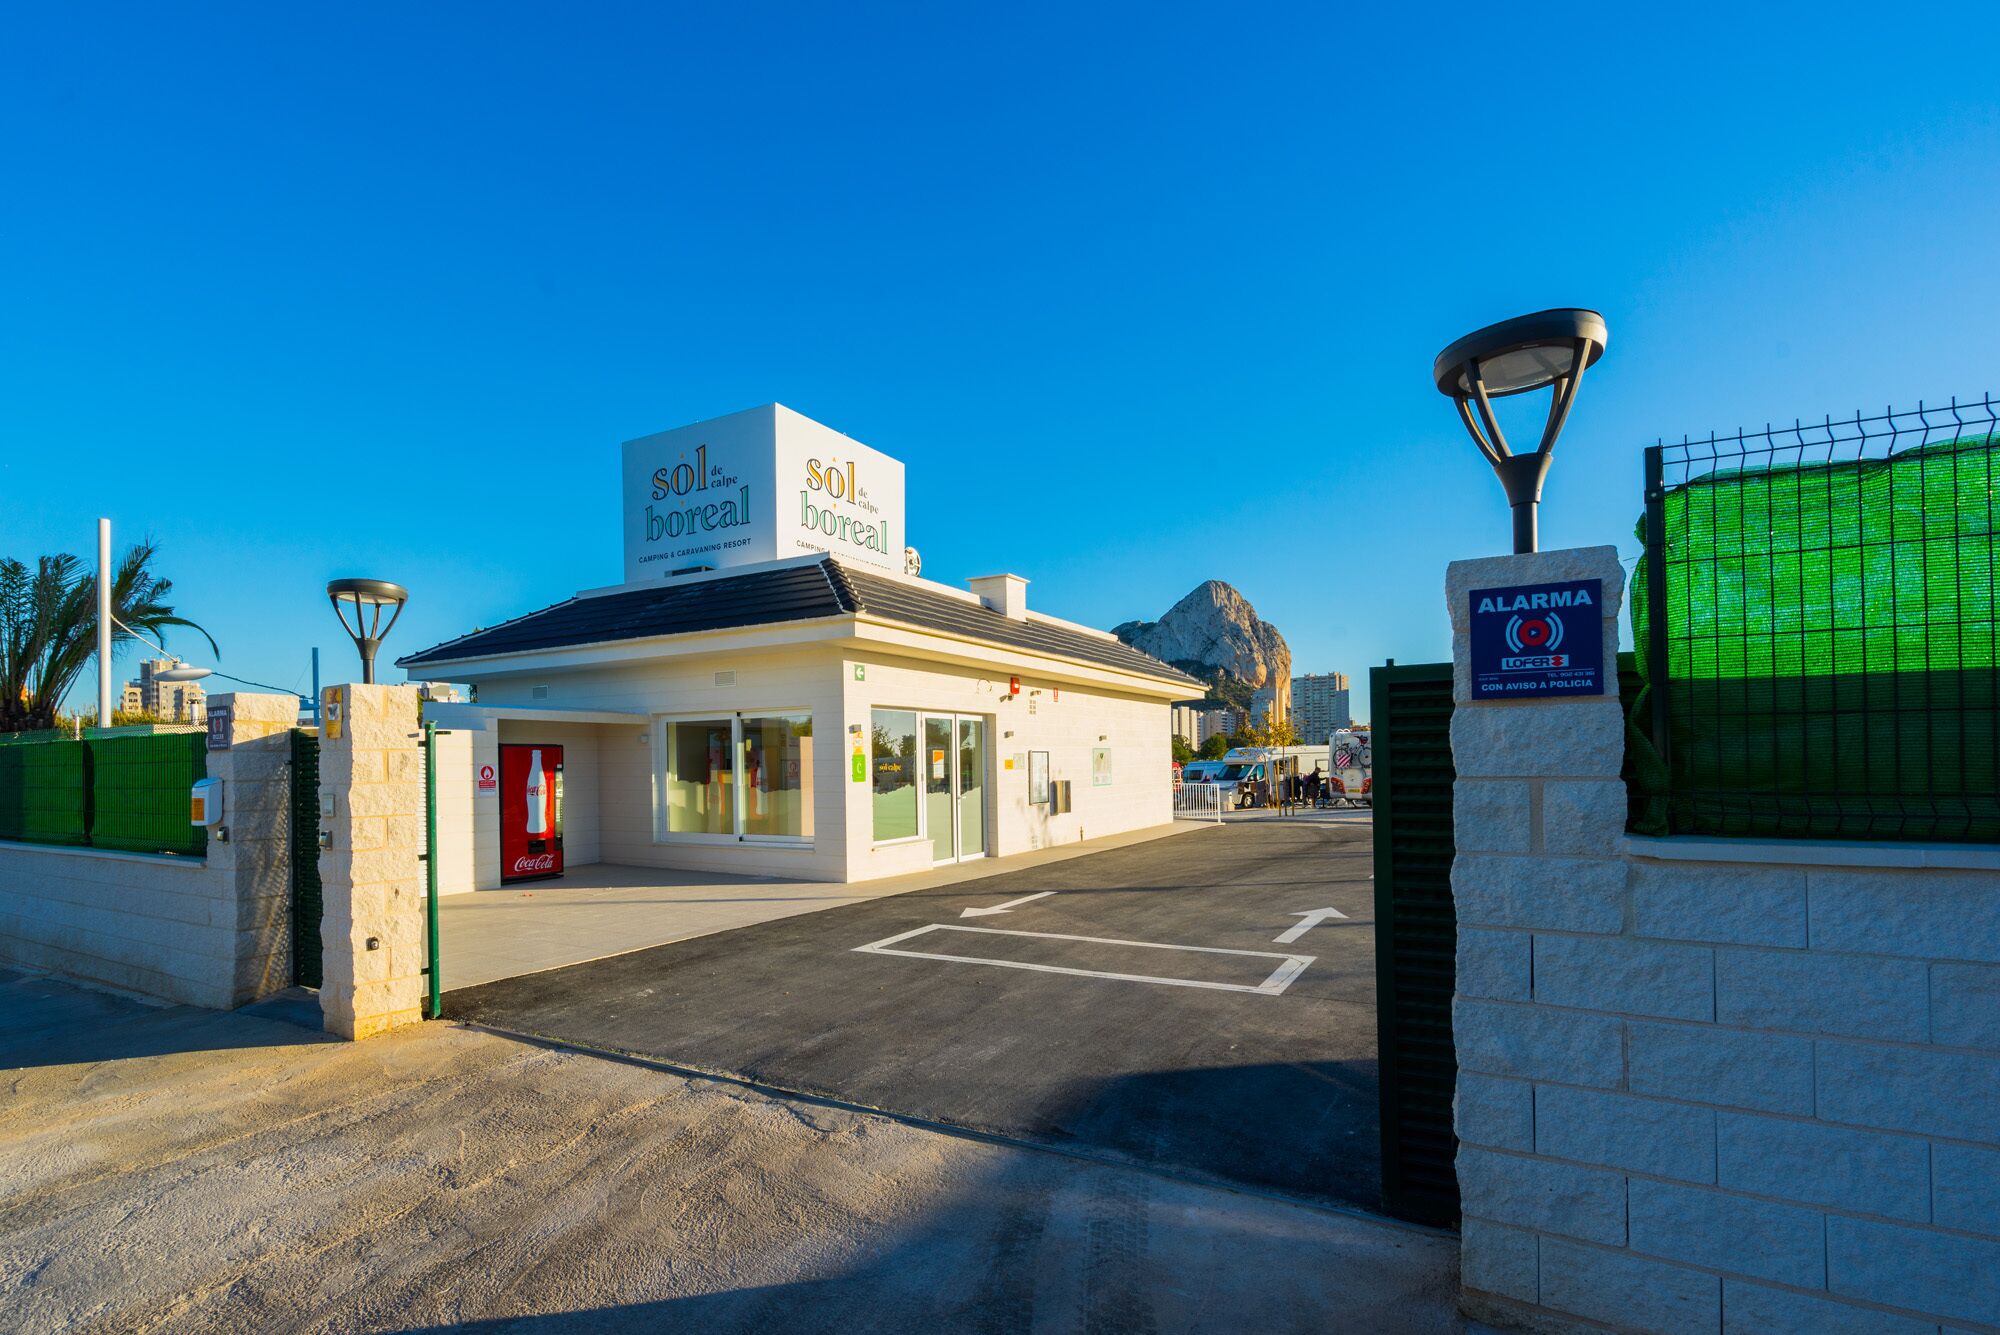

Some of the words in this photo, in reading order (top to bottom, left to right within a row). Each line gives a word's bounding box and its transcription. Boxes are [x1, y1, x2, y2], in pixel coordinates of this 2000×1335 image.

[651, 444, 707, 501] sol
[711, 465, 723, 476] de
[710, 474, 738, 489] calpe
[806, 458, 857, 506] sol
[858, 487, 868, 499] de
[645, 484, 751, 542] boreal
[858, 499, 879, 515] calpe
[800, 490, 889, 556] boreal
[638, 551, 669, 564] CAMPING
[677, 543, 721, 558] CARAVANING
[723, 537, 752, 549] RESORT
[1477, 589, 1593, 614] ALARMA
[1505, 657, 1550, 669] LOFER
[1481, 683, 1503, 691] CON
[1505, 681, 1537, 691] AVISO
[1539, 681, 1547, 689] A
[1549, 679, 1593, 689] POLICIA
